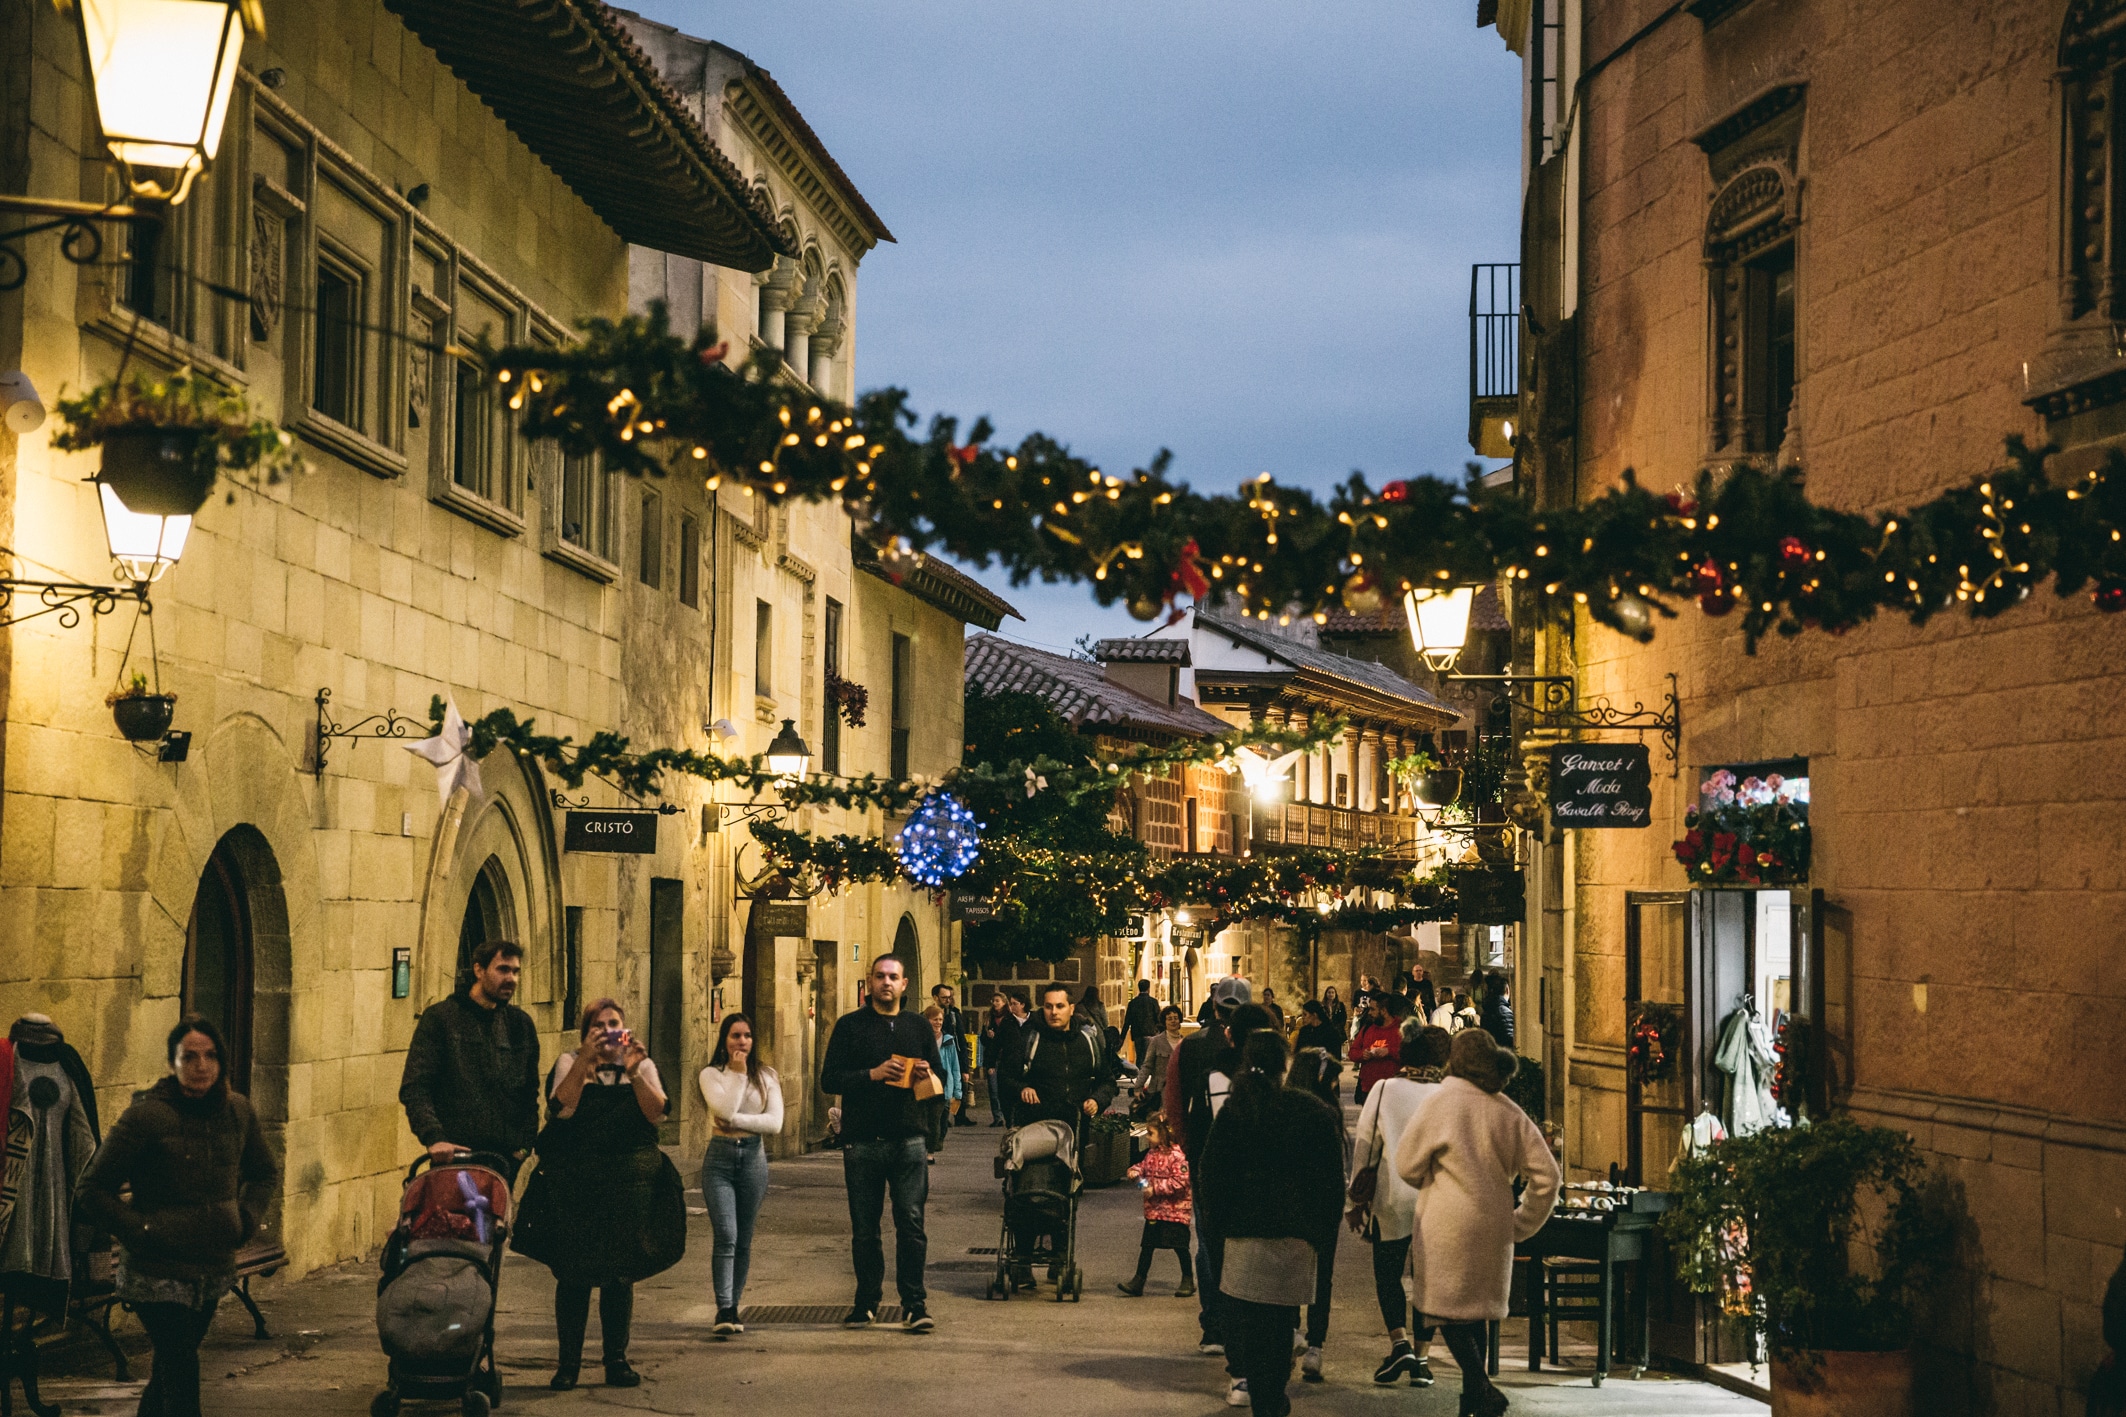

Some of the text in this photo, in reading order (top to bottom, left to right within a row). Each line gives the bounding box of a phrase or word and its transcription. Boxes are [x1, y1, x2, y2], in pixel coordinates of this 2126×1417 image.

[1560, 754, 1635, 776] Ganxet i
[1576, 777, 1622, 795] Moda
[1610, 800, 1645, 822] Roig
[584, 820, 634, 834] CRISTÓ
[1172, 926, 1202, 939] Restaurant
[1179, 937, 1194, 946] Bar
